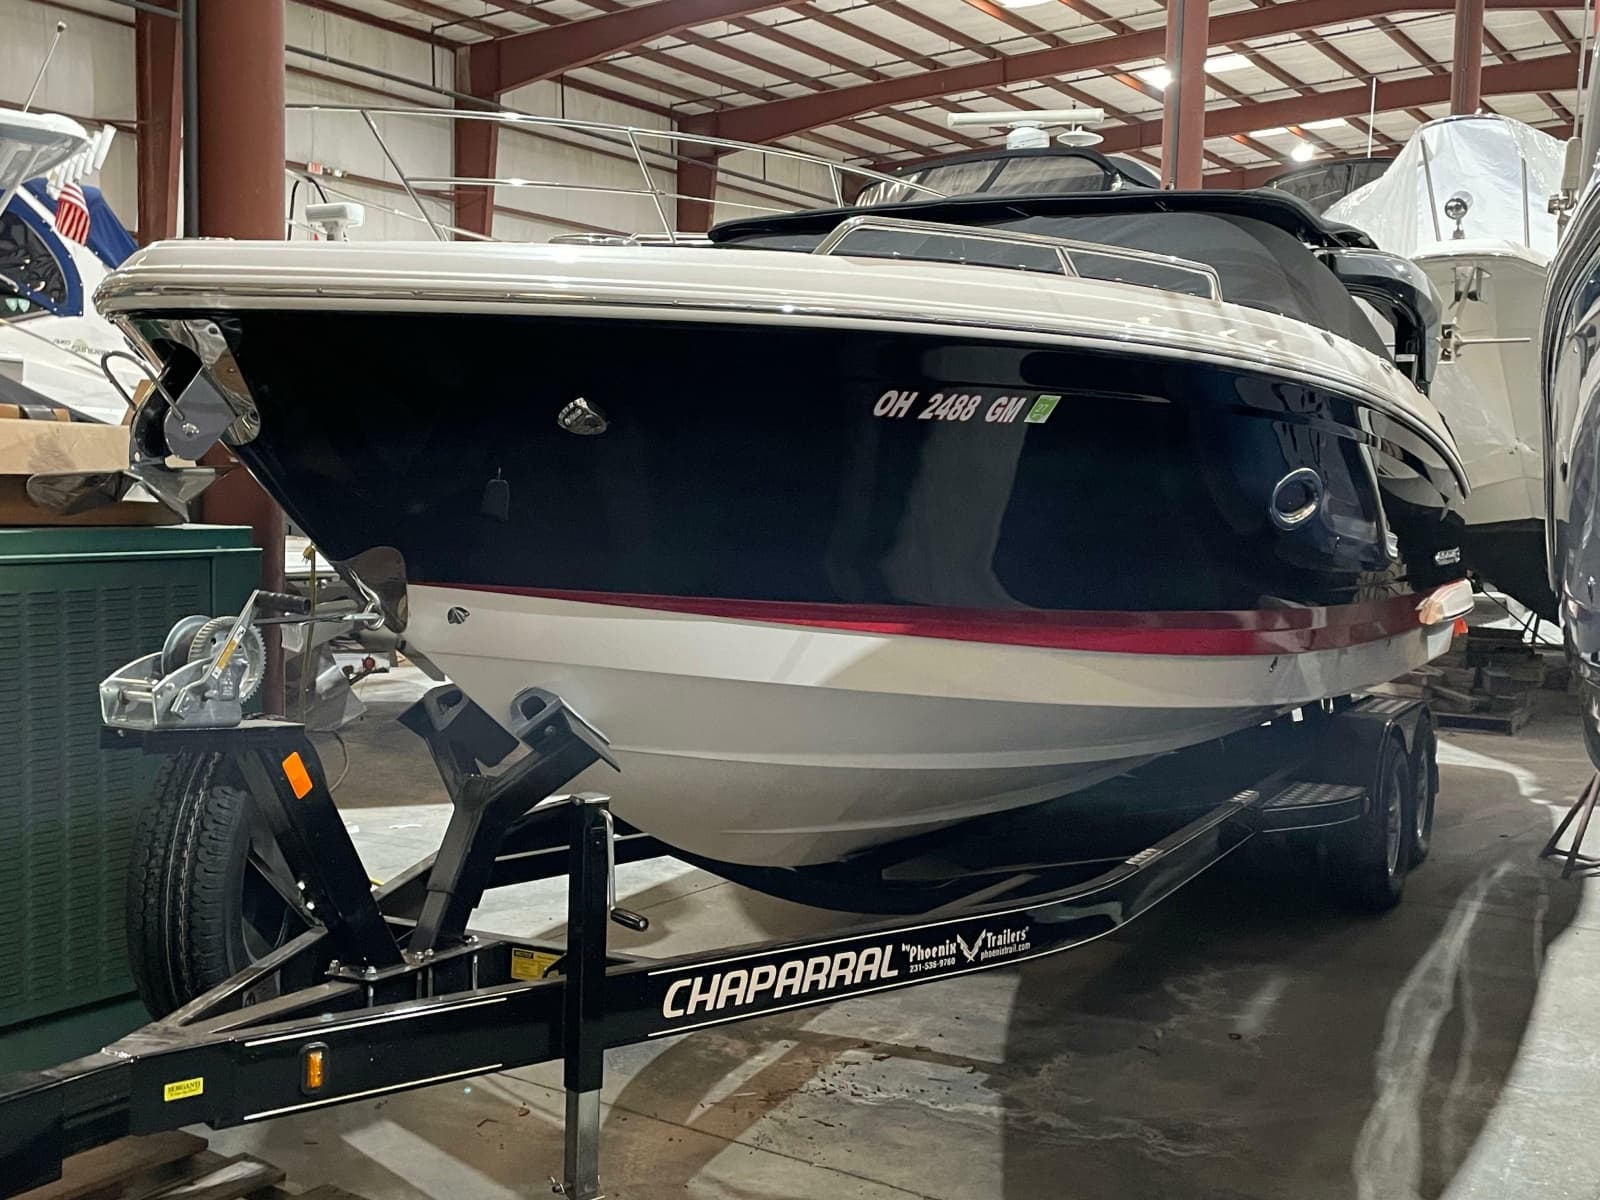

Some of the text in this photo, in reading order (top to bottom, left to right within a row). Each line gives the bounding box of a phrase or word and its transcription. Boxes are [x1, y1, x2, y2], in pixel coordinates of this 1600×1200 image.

[873, 390, 1027, 423] OH 2488 GM
[909, 939, 957, 962] Phoenix
[986, 928, 1026, 948] Trailers
[663, 945, 899, 1018] CHAPARRAL
